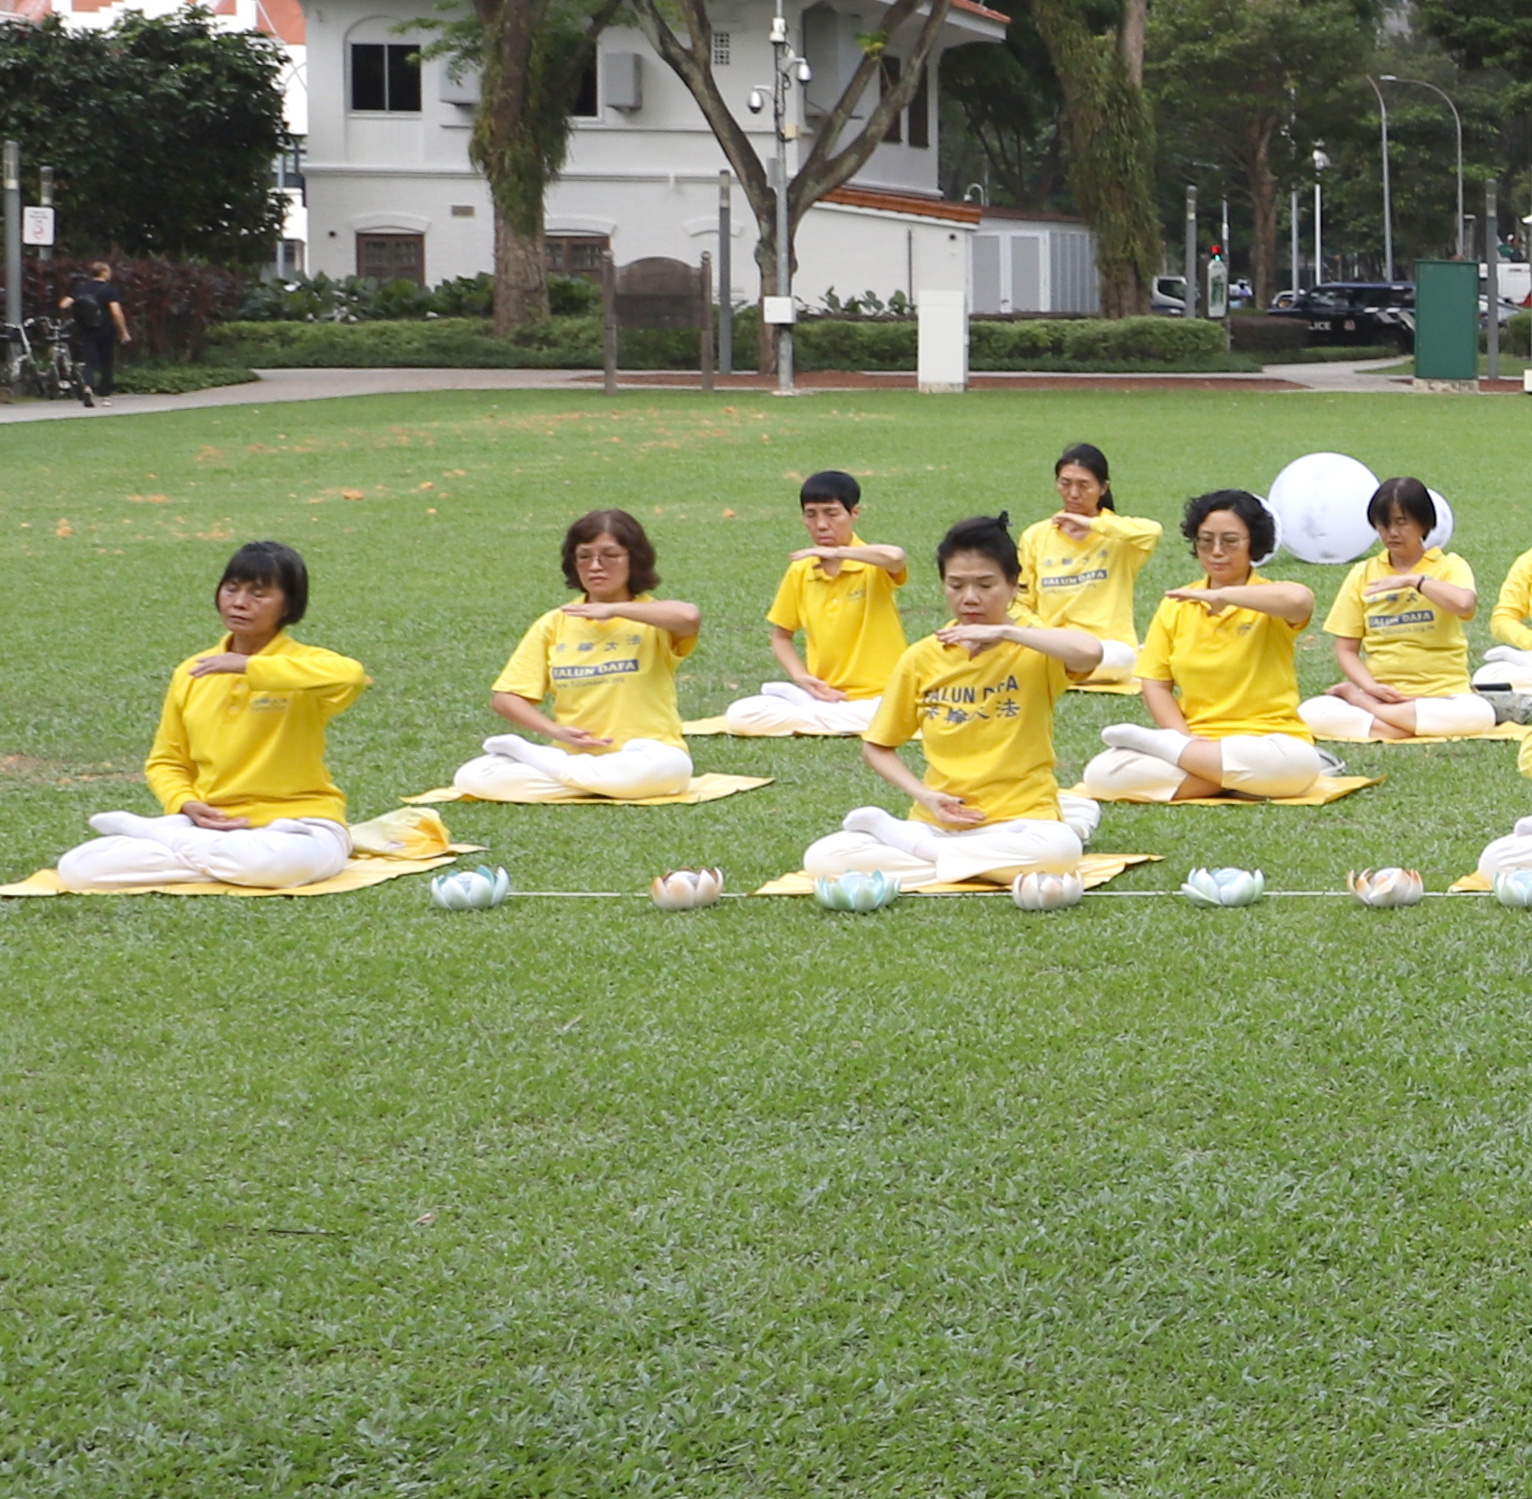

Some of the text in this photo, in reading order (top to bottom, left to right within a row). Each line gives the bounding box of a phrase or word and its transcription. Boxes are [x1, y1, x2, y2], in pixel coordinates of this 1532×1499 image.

[1079, 570, 1107, 583] DAFA
[1402, 611, 1432, 622] DAFA
[598, 660, 636, 674] DAFA
